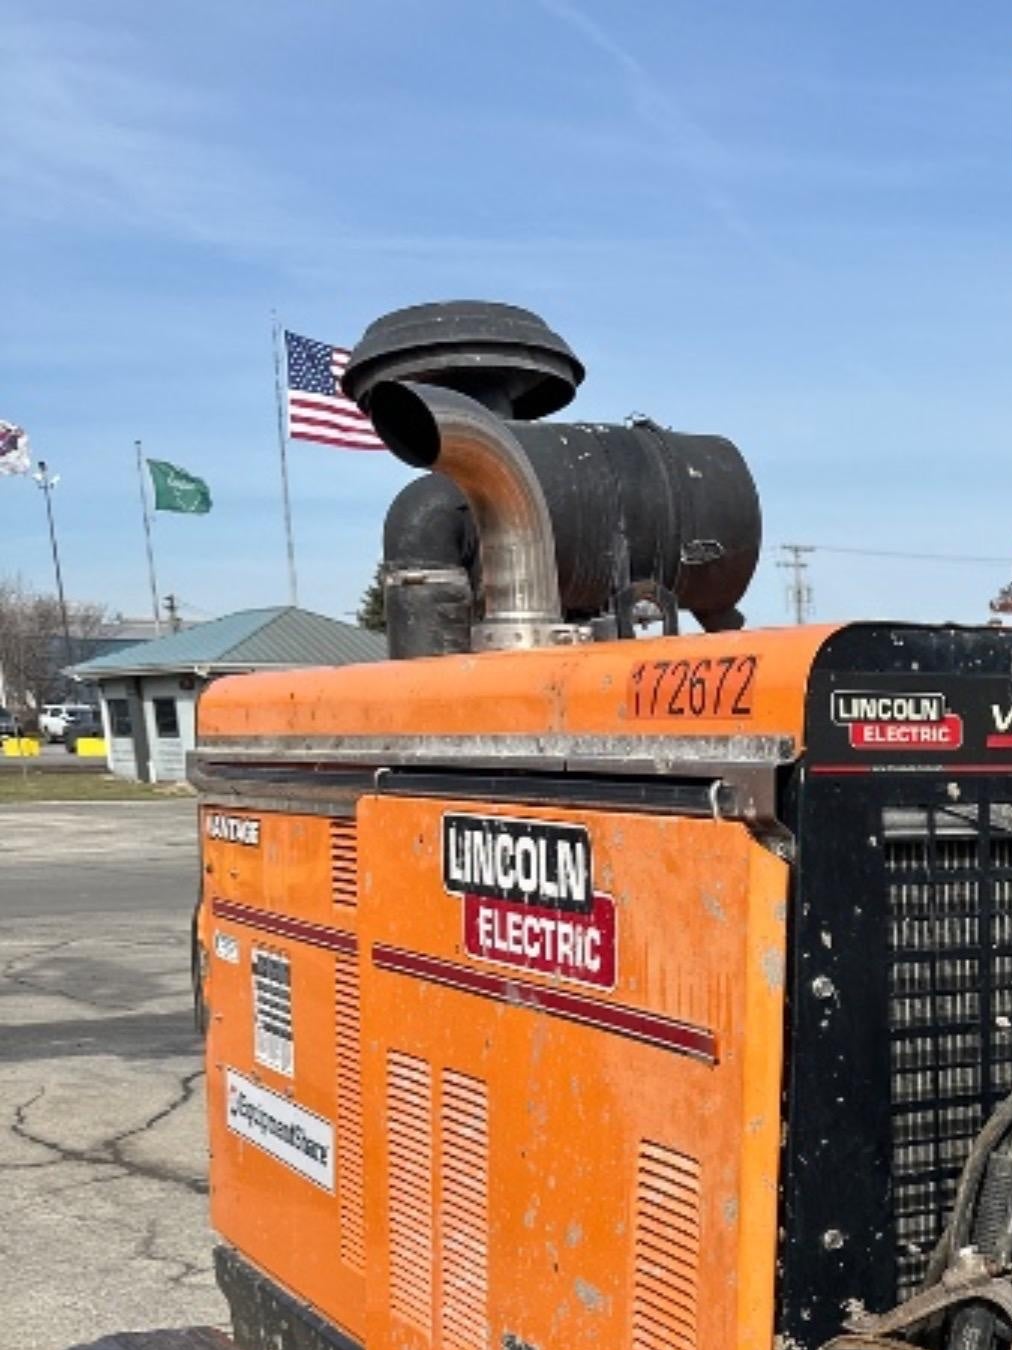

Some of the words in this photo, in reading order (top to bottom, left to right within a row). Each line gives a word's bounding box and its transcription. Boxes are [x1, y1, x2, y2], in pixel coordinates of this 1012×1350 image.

[632, 654, 757, 717] 172672
[839, 698, 937, 720] LINCOLN
[863, 725, 951, 743] ELECTRIC
[449, 827, 587, 901] LINCOLN
[478, 905, 601, 973] ELECTRIC
